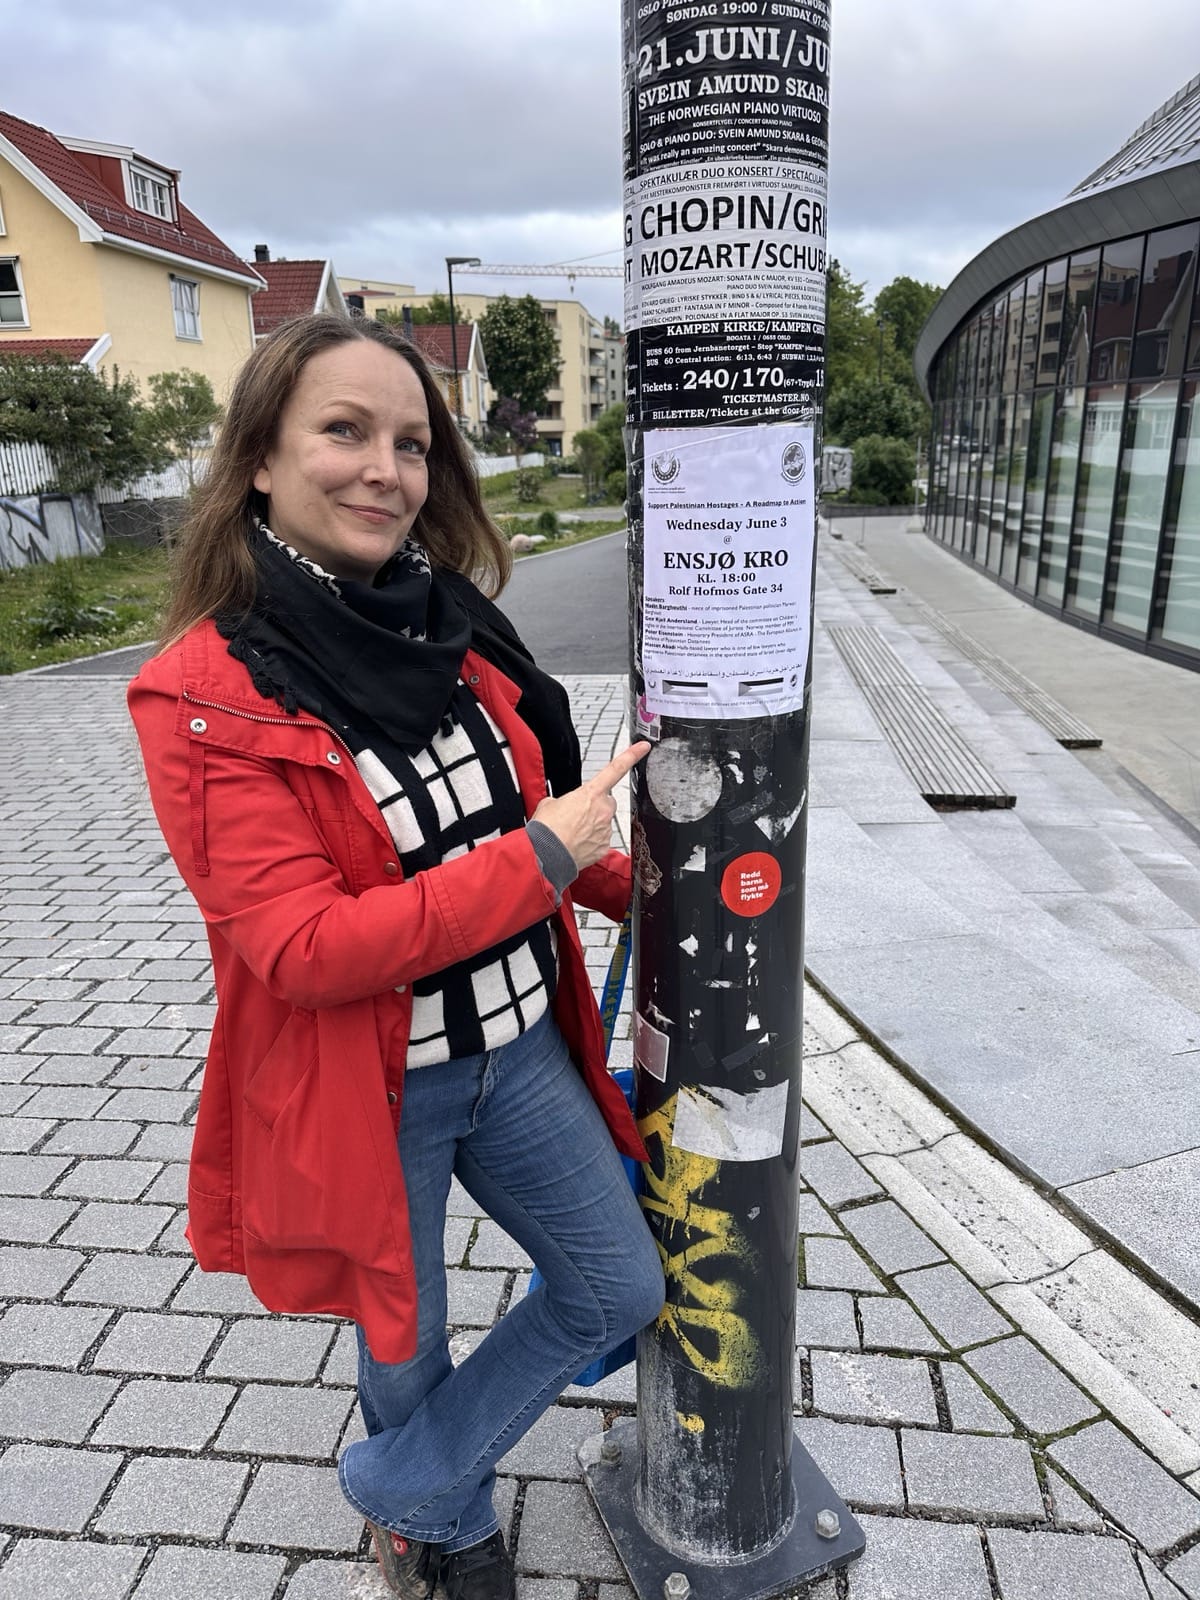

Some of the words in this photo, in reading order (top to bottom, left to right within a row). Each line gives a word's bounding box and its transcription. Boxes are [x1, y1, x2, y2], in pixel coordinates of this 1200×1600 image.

[667, 4, 719, 24] SØNDAG
[722, 2, 758, 15] 19:00
[771, 3, 812, 23] SUNDAY
[638, 79, 691, 111] SVEIN
[698, 75, 780, 97] AMUND
[785, 77, 831, 111] SKARA
[648, 112, 666, 128] THE
[668, 102, 741, 123] NORWEGIAN
[744, 102, 780, 116] PIANO
[781, 103, 822, 124] VIRTUOSO
[761, 118, 779, 126] GRAND
[779, 119, 794, 128] PIANO
[640, 141, 656, 154] SOLO
[664, 132, 691, 147] PIANO
[692, 130, 717, 142] DUO:
[718, 128, 745, 140] SVEIN
[746, 127, 781, 139] AMUND
[782, 129, 805, 143] SKARA
[660, 148, 680, 160] really
[680, 148, 690, 157] an
[691, 143, 726, 155] amazing
[640, 169, 699, 190] SPEKTAKULÆR
[701, 167, 725, 179] DUO
[728, 166, 774, 178] KONSERT
[650, 182, 711, 199] MESTERKOMPONISTER
[712, 180, 747, 190] FREMFØRT
[752, 181, 780, 190] VIRTUOST
[667, 277, 696, 288] AMADEUS
[697, 275, 726, 285] MOZART:
[727, 274, 752, 282] SONATA
[726, 283, 744, 291] PIANO
[677, 295, 700, 304] LYRISKE
[700, 293, 728, 302] STYKKER
[763, 292, 784, 300] LYRICAL
[684, 303, 714, 312] FANTASIA
[714, 303, 722, 311] IN
[728, 302, 750, 310] MINOR
[755, 302, 784, 310] Composed
[685, 311, 719, 321] POLONAISE
[720, 311, 727, 319] IN
[750, 311, 770, 319] MAJOR
[666, 322, 720, 337] KAMPEN
[723, 320, 812, 334] KIRKE/KAMPEN
[646, 348, 663, 357] BUSS
[663, 347, 674, 355] 60
[674, 345, 692, 355] from
[693, 344, 750, 354] Jernbanetorget
[757, 343, 774, 352] Stop
[646, 358, 659, 368] BUS
[664, 357, 674, 366] 60
[675, 355, 702, 365] Central
[703, 354, 732, 363] station:
[757, 353, 773, 361] 6:43
[641, 381, 673, 393] Tickets
[683, 367, 785, 392] 240/170
[722, 393, 811, 405] TICKETMASTER.NO
[652, 406, 750, 421] BILLETTER/Tickets
[751, 408, 763, 416] at
[764, 405, 781, 415] the
[648, 502, 669, 511] Support
[670, 501, 706, 510] Palestinian
[706, 501, 739, 510] Hostages
[752, 499, 782, 508] Roadmap
[782, 499, 789, 507] to
[790, 498, 807, 507] Action
[666, 518, 743, 533] Wednesday
[746, 518, 778, 530] June
[780, 516, 788, 528] 3
[723, 535, 733, 545] @
[663, 550, 736, 571] ENSJØ
[743, 549, 789, 569] KRO
[697, 573, 717, 584] KL.
[721, 572, 756, 583] 18:00
[669, 585, 691, 596] Rolf
[694, 586, 740, 596] Hofmos
[743, 585, 769, 595] Gate
[770, 583, 784, 594] 34
[740, 870, 761, 880] Redd
[740, 878, 763, 887] barna
[740, 886, 757, 894] som
[757, 881, 769, 891] må
[740, 892, 764, 902] flykte
